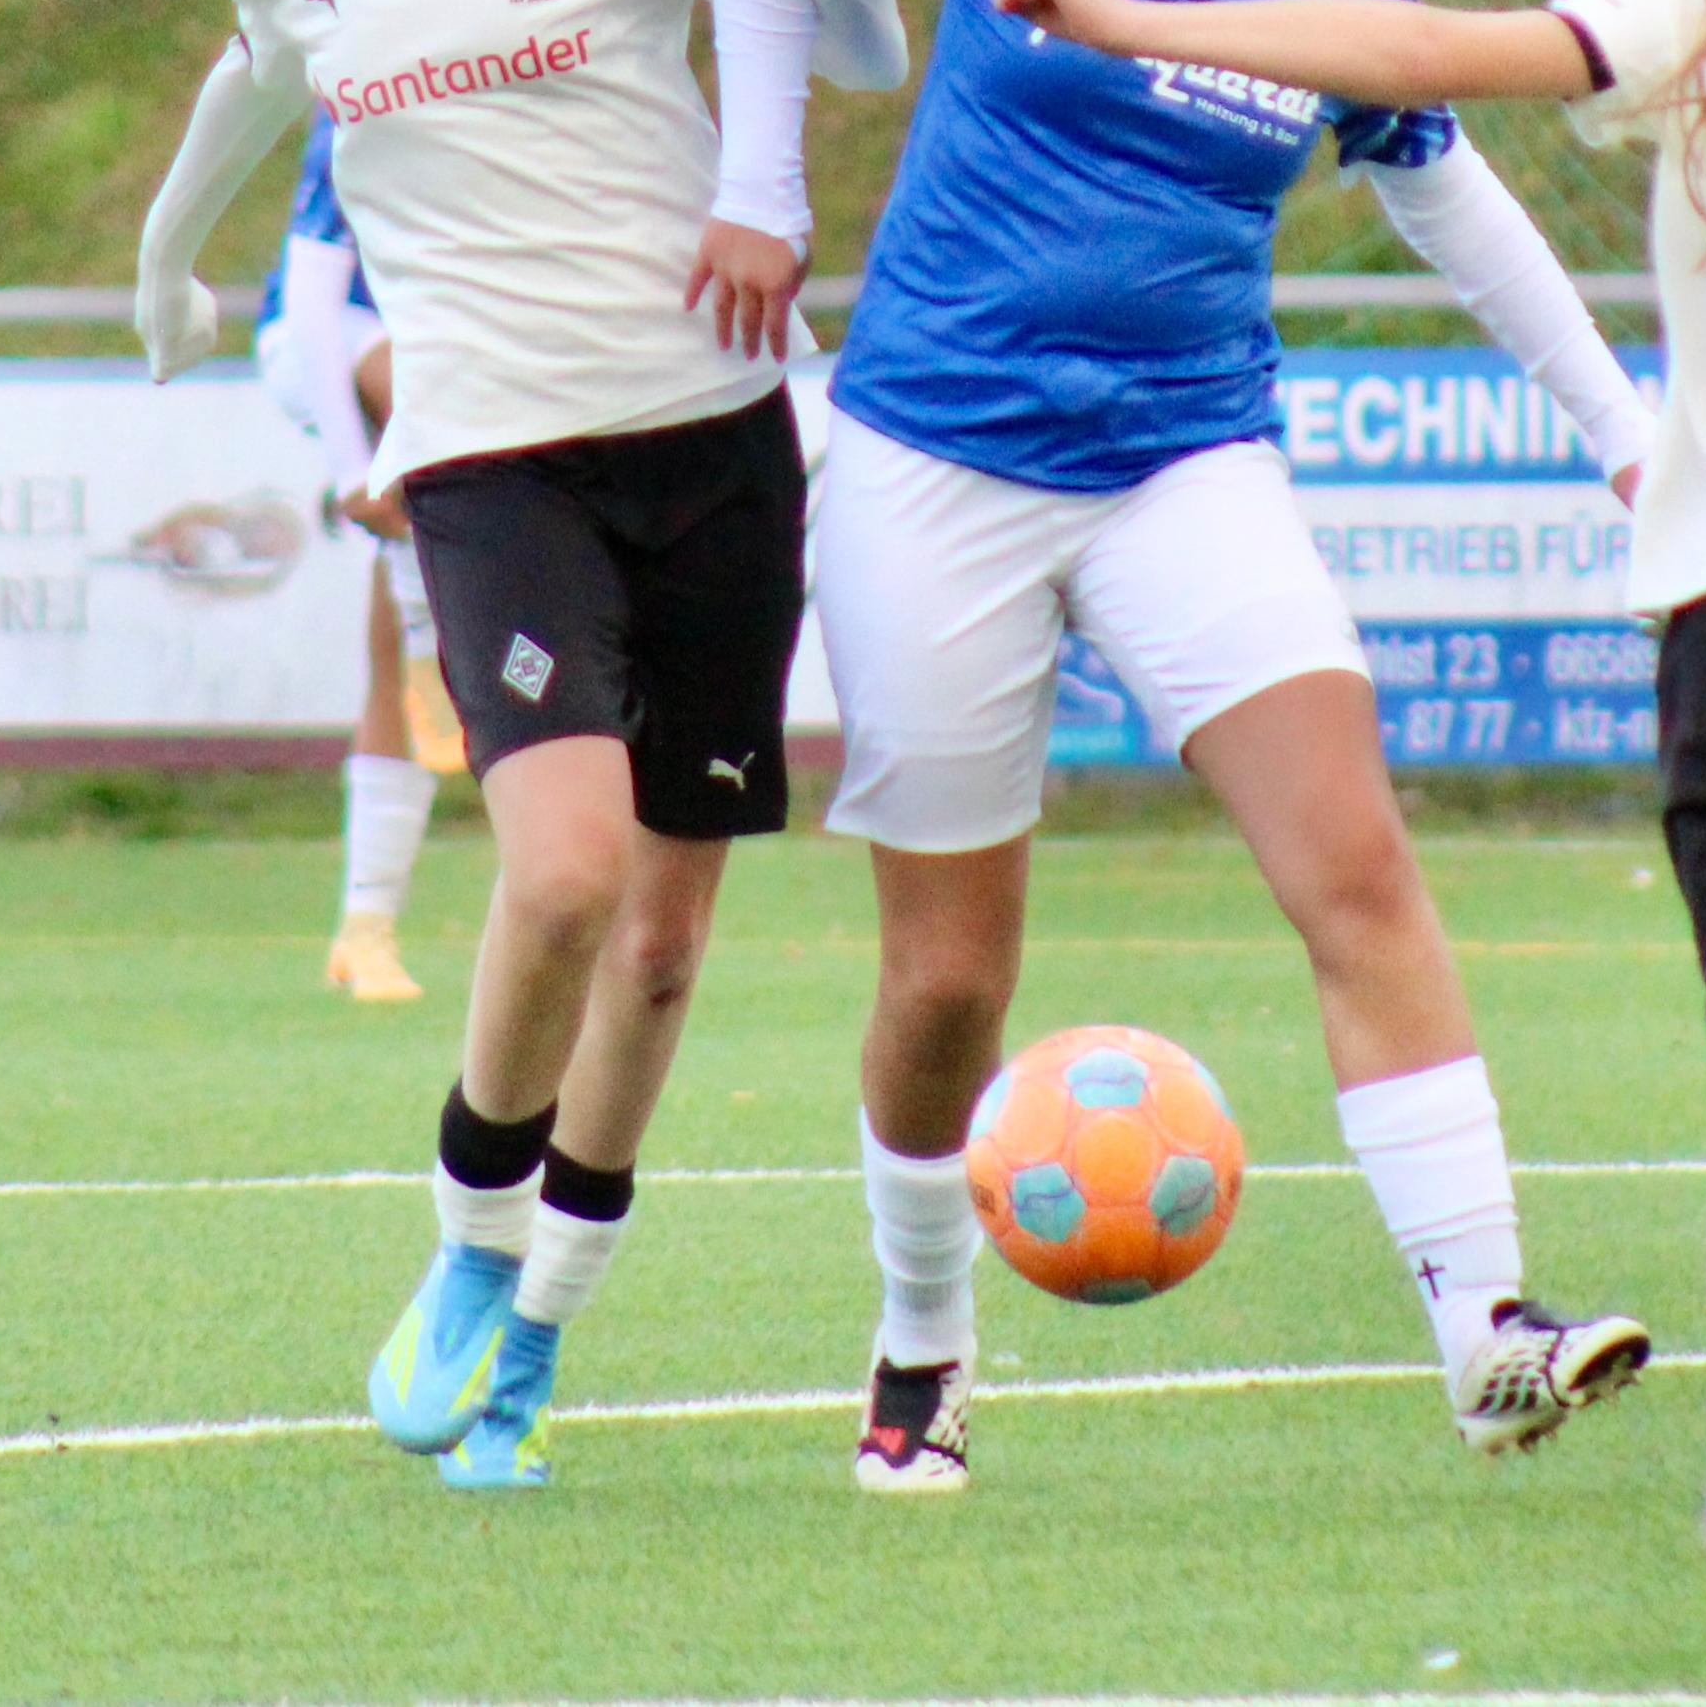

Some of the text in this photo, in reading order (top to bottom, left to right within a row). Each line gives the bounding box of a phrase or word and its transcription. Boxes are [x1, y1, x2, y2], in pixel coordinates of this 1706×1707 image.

[336, 27, 591, 124] Santander
[1195, 97, 1260, 135] Heizung
[1448, 634, 1498, 684] 23
[1464, 699, 1514, 751] 77
